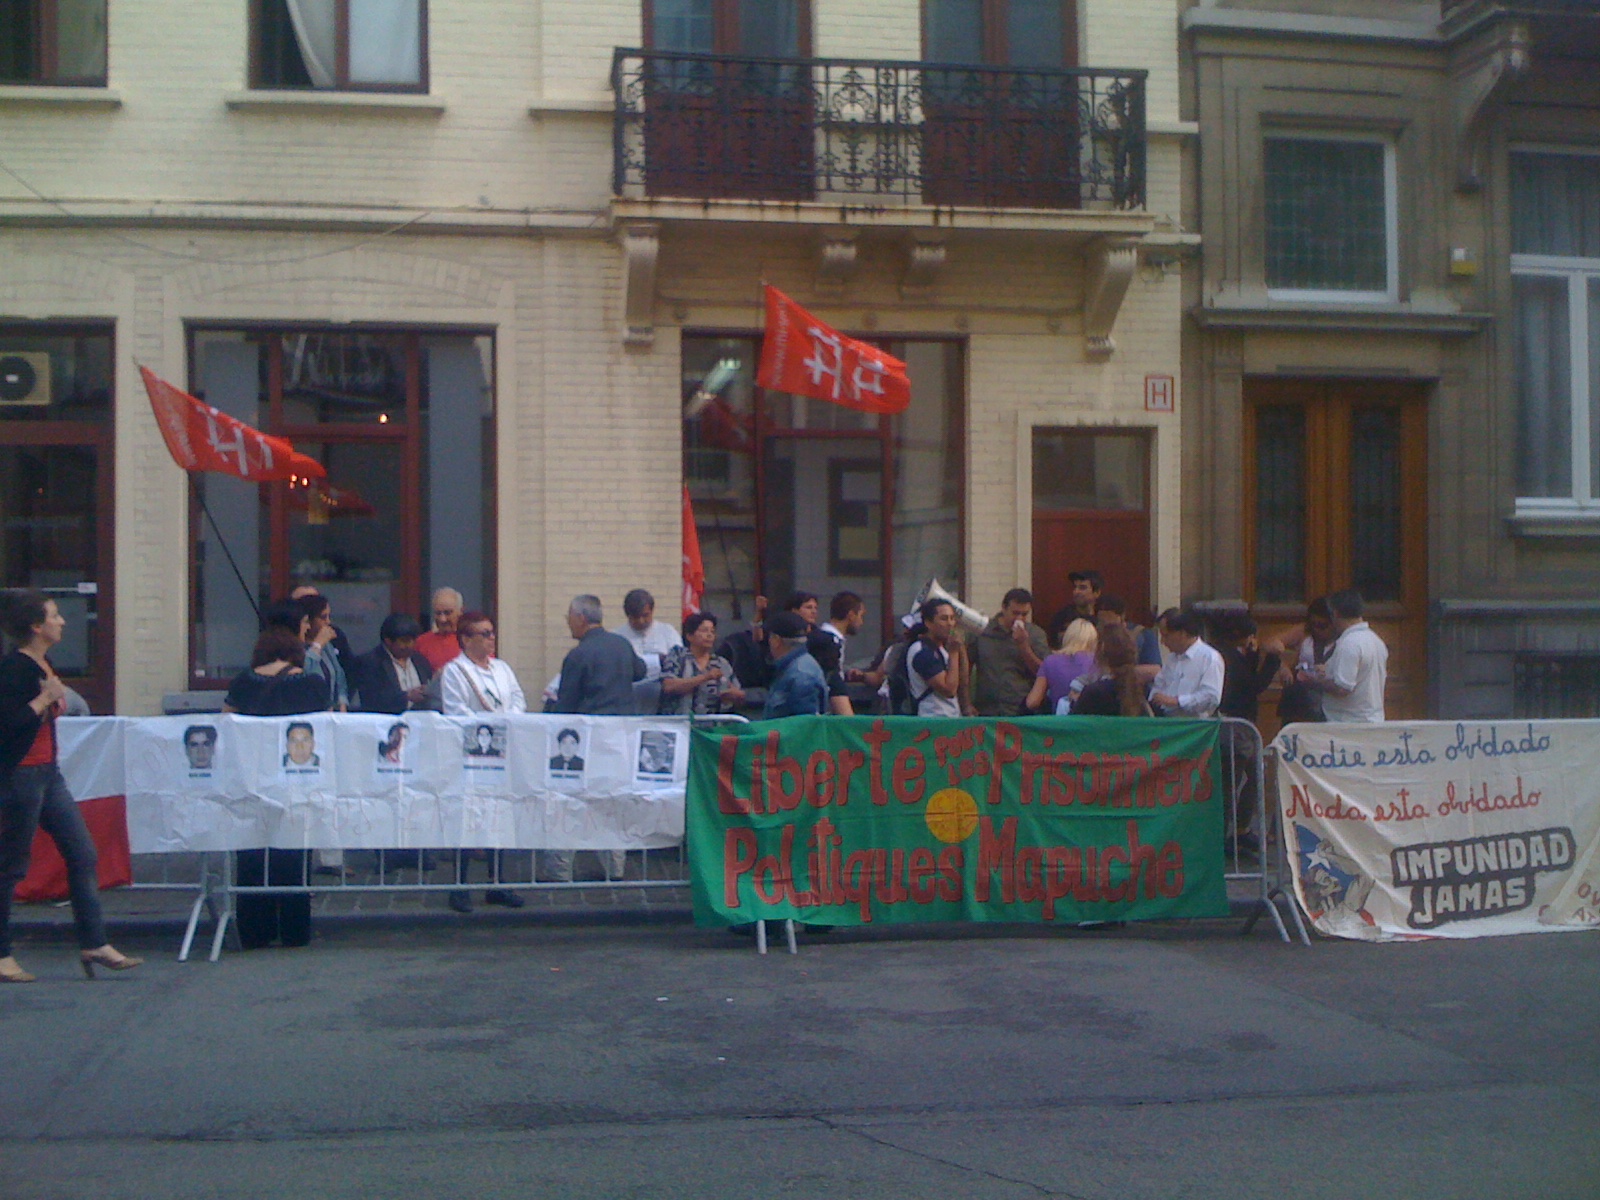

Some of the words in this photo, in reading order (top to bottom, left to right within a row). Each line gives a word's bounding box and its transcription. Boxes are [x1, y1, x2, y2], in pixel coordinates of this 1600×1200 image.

[1151, 382, 1168, 405] H
[717, 719, 931, 815] Liberté
[988, 721, 1214, 808] Prisonniers
[1373, 732, 1436, 766] esta
[1445, 723, 1550, 760] olvidado
[1286, 784, 1367, 819] Nada
[1373, 788, 1430, 821] esta
[1438, 776, 1542, 816] olvidado
[974, 815, 1184, 920] Mapuche
[1394, 832, 1571, 882] IMPUNIDAD
[1413, 876, 1527, 924] JAMAS
